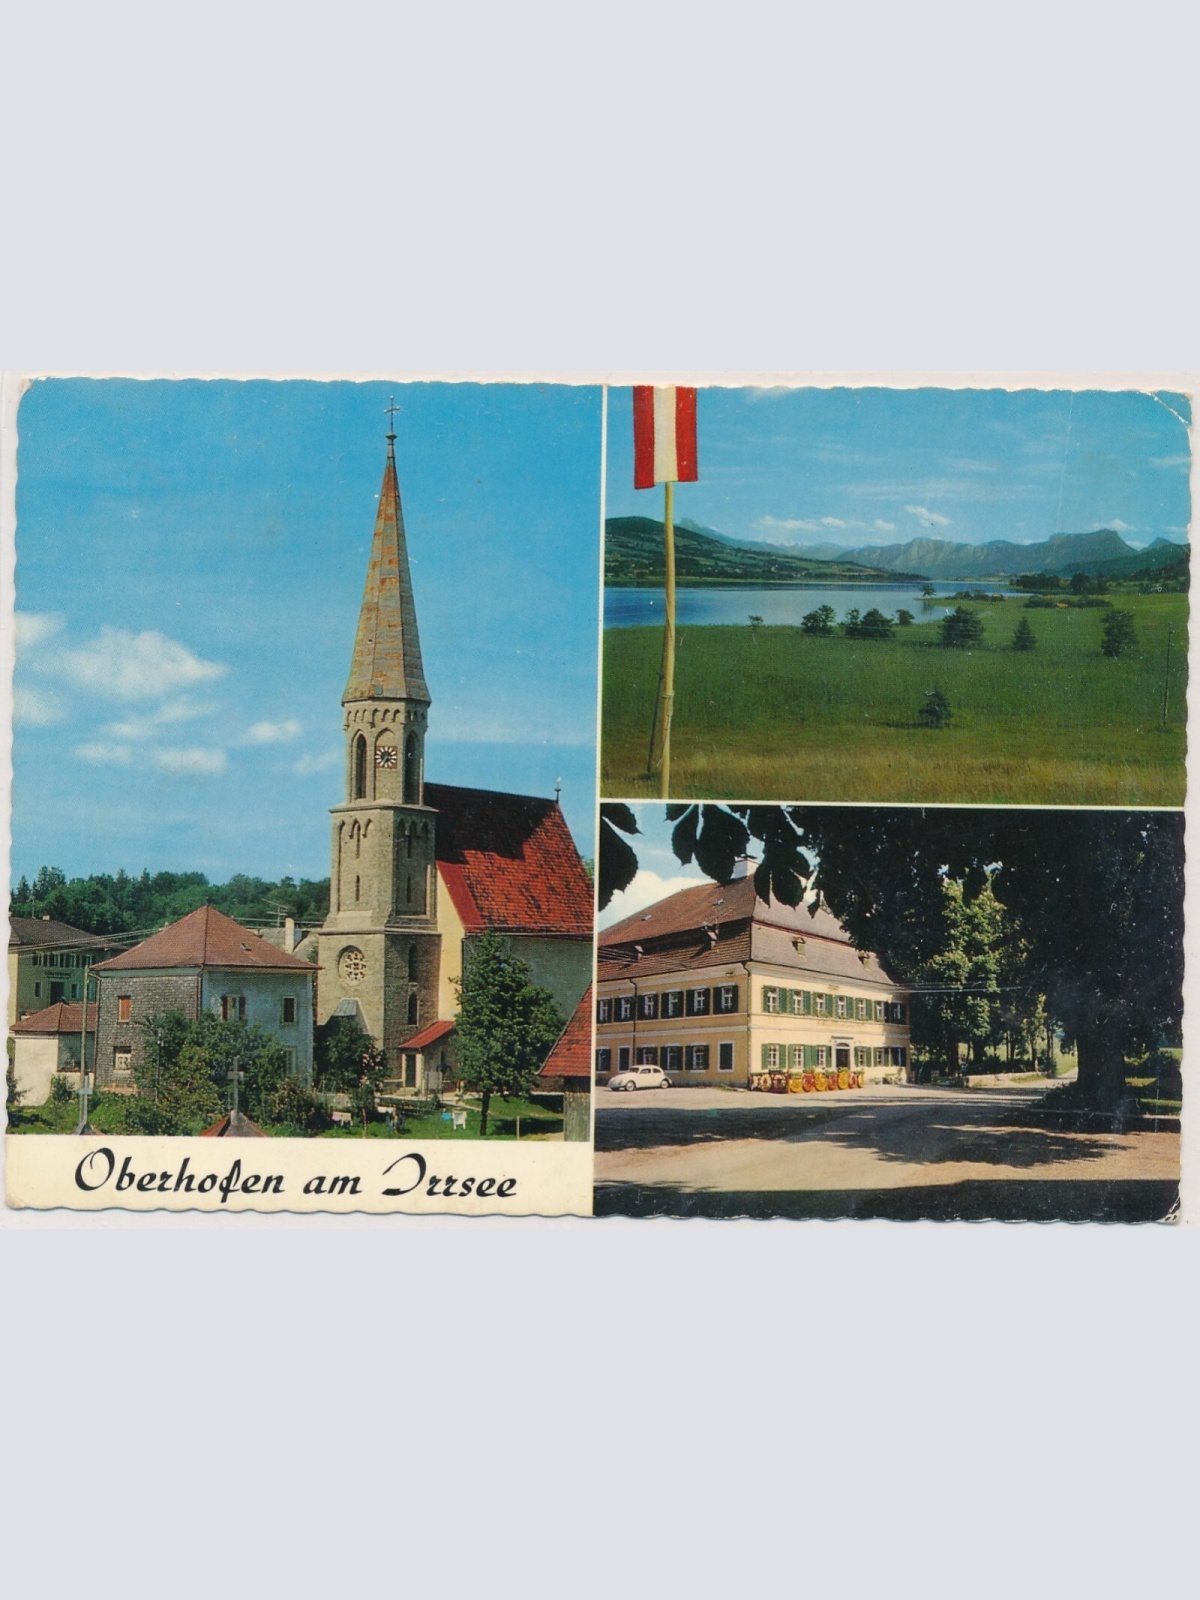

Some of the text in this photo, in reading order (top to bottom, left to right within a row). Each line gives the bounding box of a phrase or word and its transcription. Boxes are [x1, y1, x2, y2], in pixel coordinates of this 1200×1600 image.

[74, 1147, 517, 1203] Oberhofen am Irrsee
